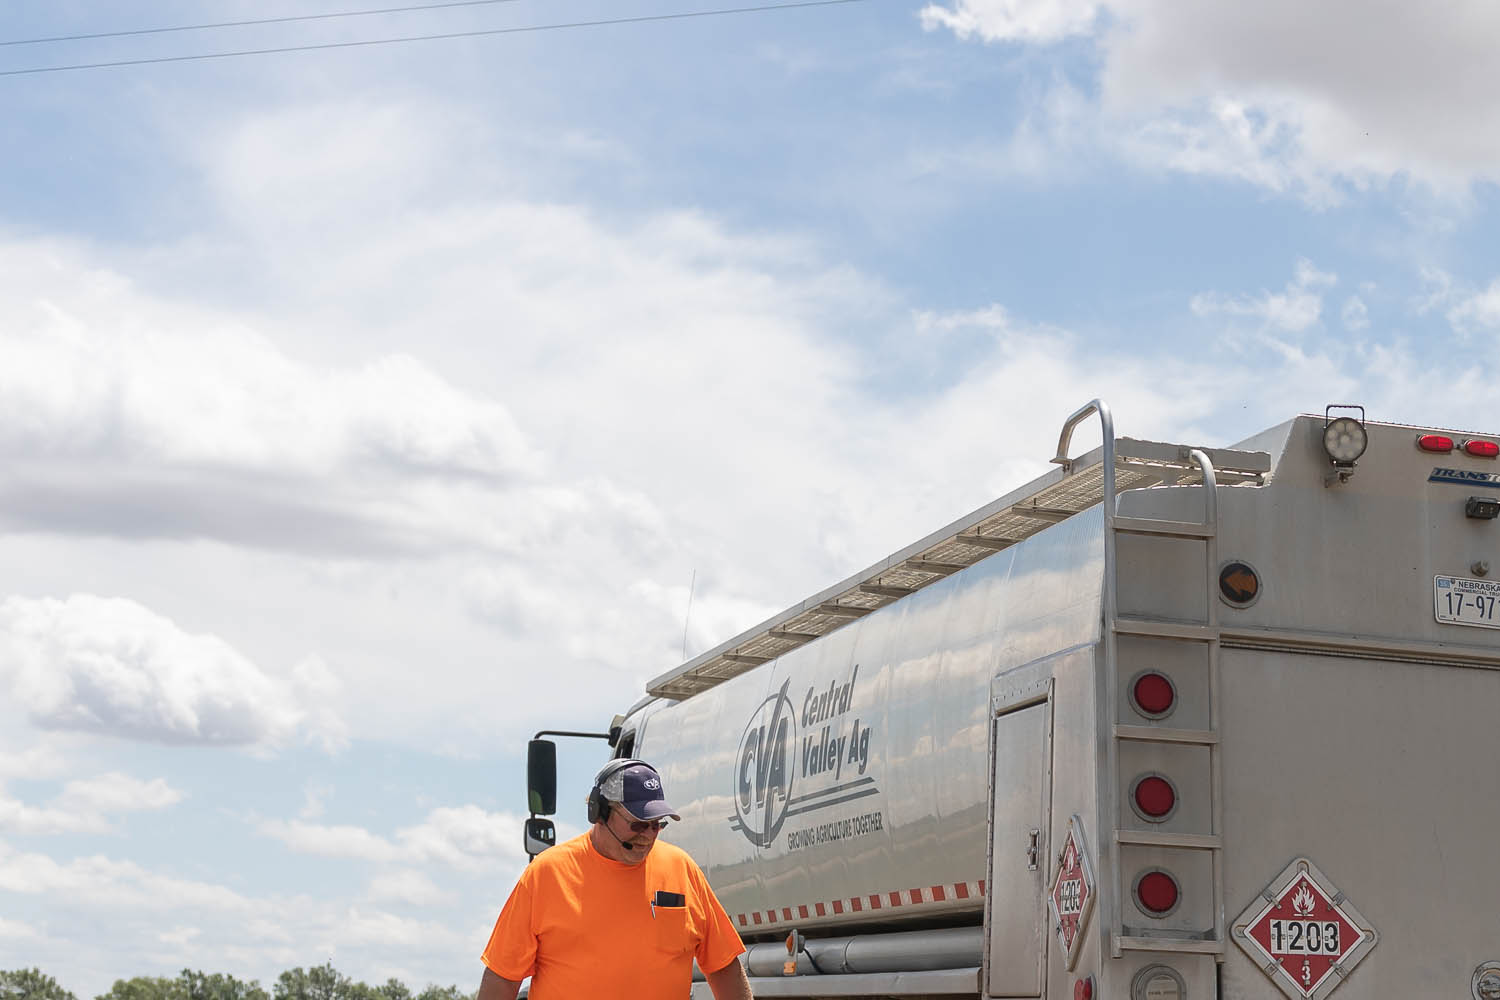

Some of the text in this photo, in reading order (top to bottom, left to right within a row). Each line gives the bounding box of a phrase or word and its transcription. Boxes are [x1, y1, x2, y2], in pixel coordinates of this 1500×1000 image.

[1454, 587, 1487, 596] COMMERCIAL
[802, 664, 859, 728] Central
[802, 719, 871, 780] Valley Ag
[788, 811, 883, 850] GROWING AGRICULTURE TOGETHER
[1272, 920, 1339, 952] 1203
[1301, 965, 1311, 980] 3
